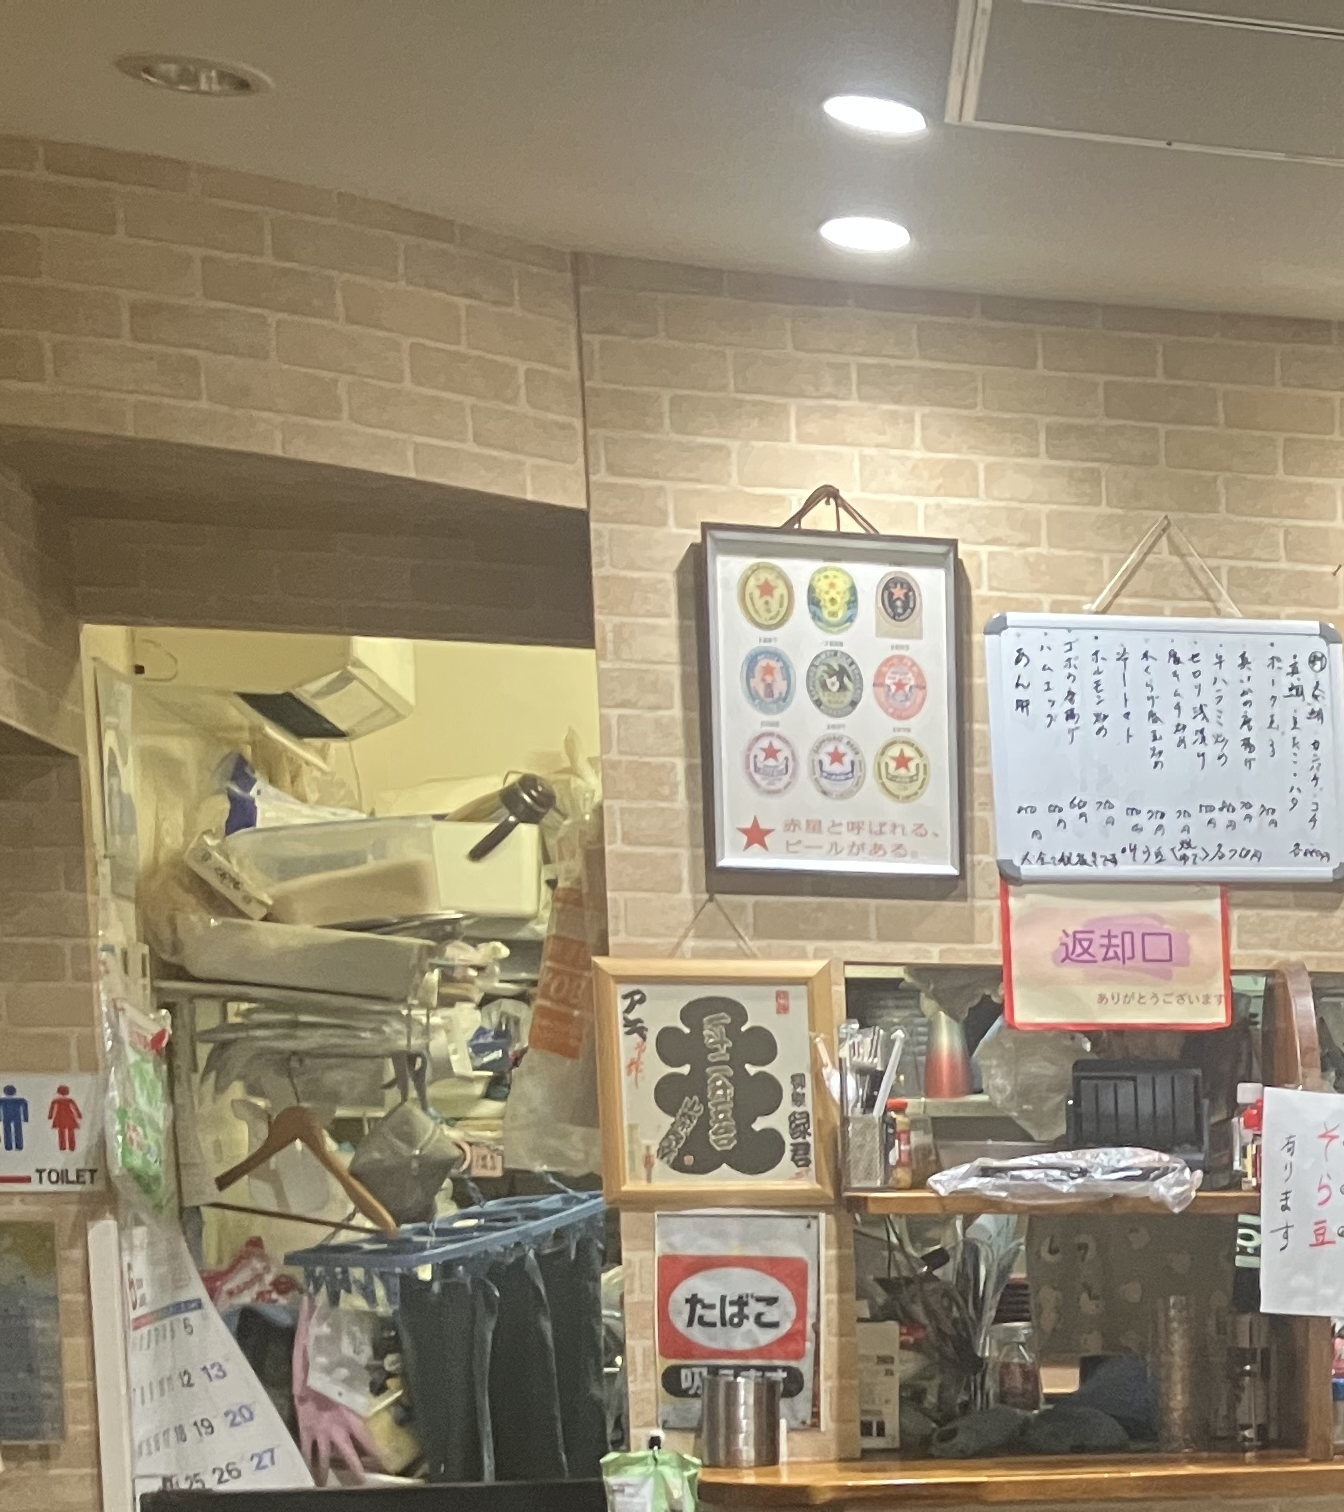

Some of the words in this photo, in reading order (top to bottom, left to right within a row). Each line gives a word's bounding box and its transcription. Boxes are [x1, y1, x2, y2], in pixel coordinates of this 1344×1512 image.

[783, 817, 939, 838] 赤星と呼ばれる、
[784, 839, 920, 860] ビールがある。
[1060, 929, 1174, 966] 返却口
[1096, 992, 1225, 1007] ありがとうございます
[35, 1168, 99, 1185] TOILET
[1269, 1133, 1298, 1252] 有ります
[1308, 1121, 1341, 1248] そら豆
[684, 1294, 780, 1329] たばこ
[200, 1361, 227, 1383] 13
[192, 1417, 215, 1437] 19
[223, 1403, 255, 1429] 20
[212, 1461, 242, 1485] 26
[250, 1447, 278, 1472] 27
